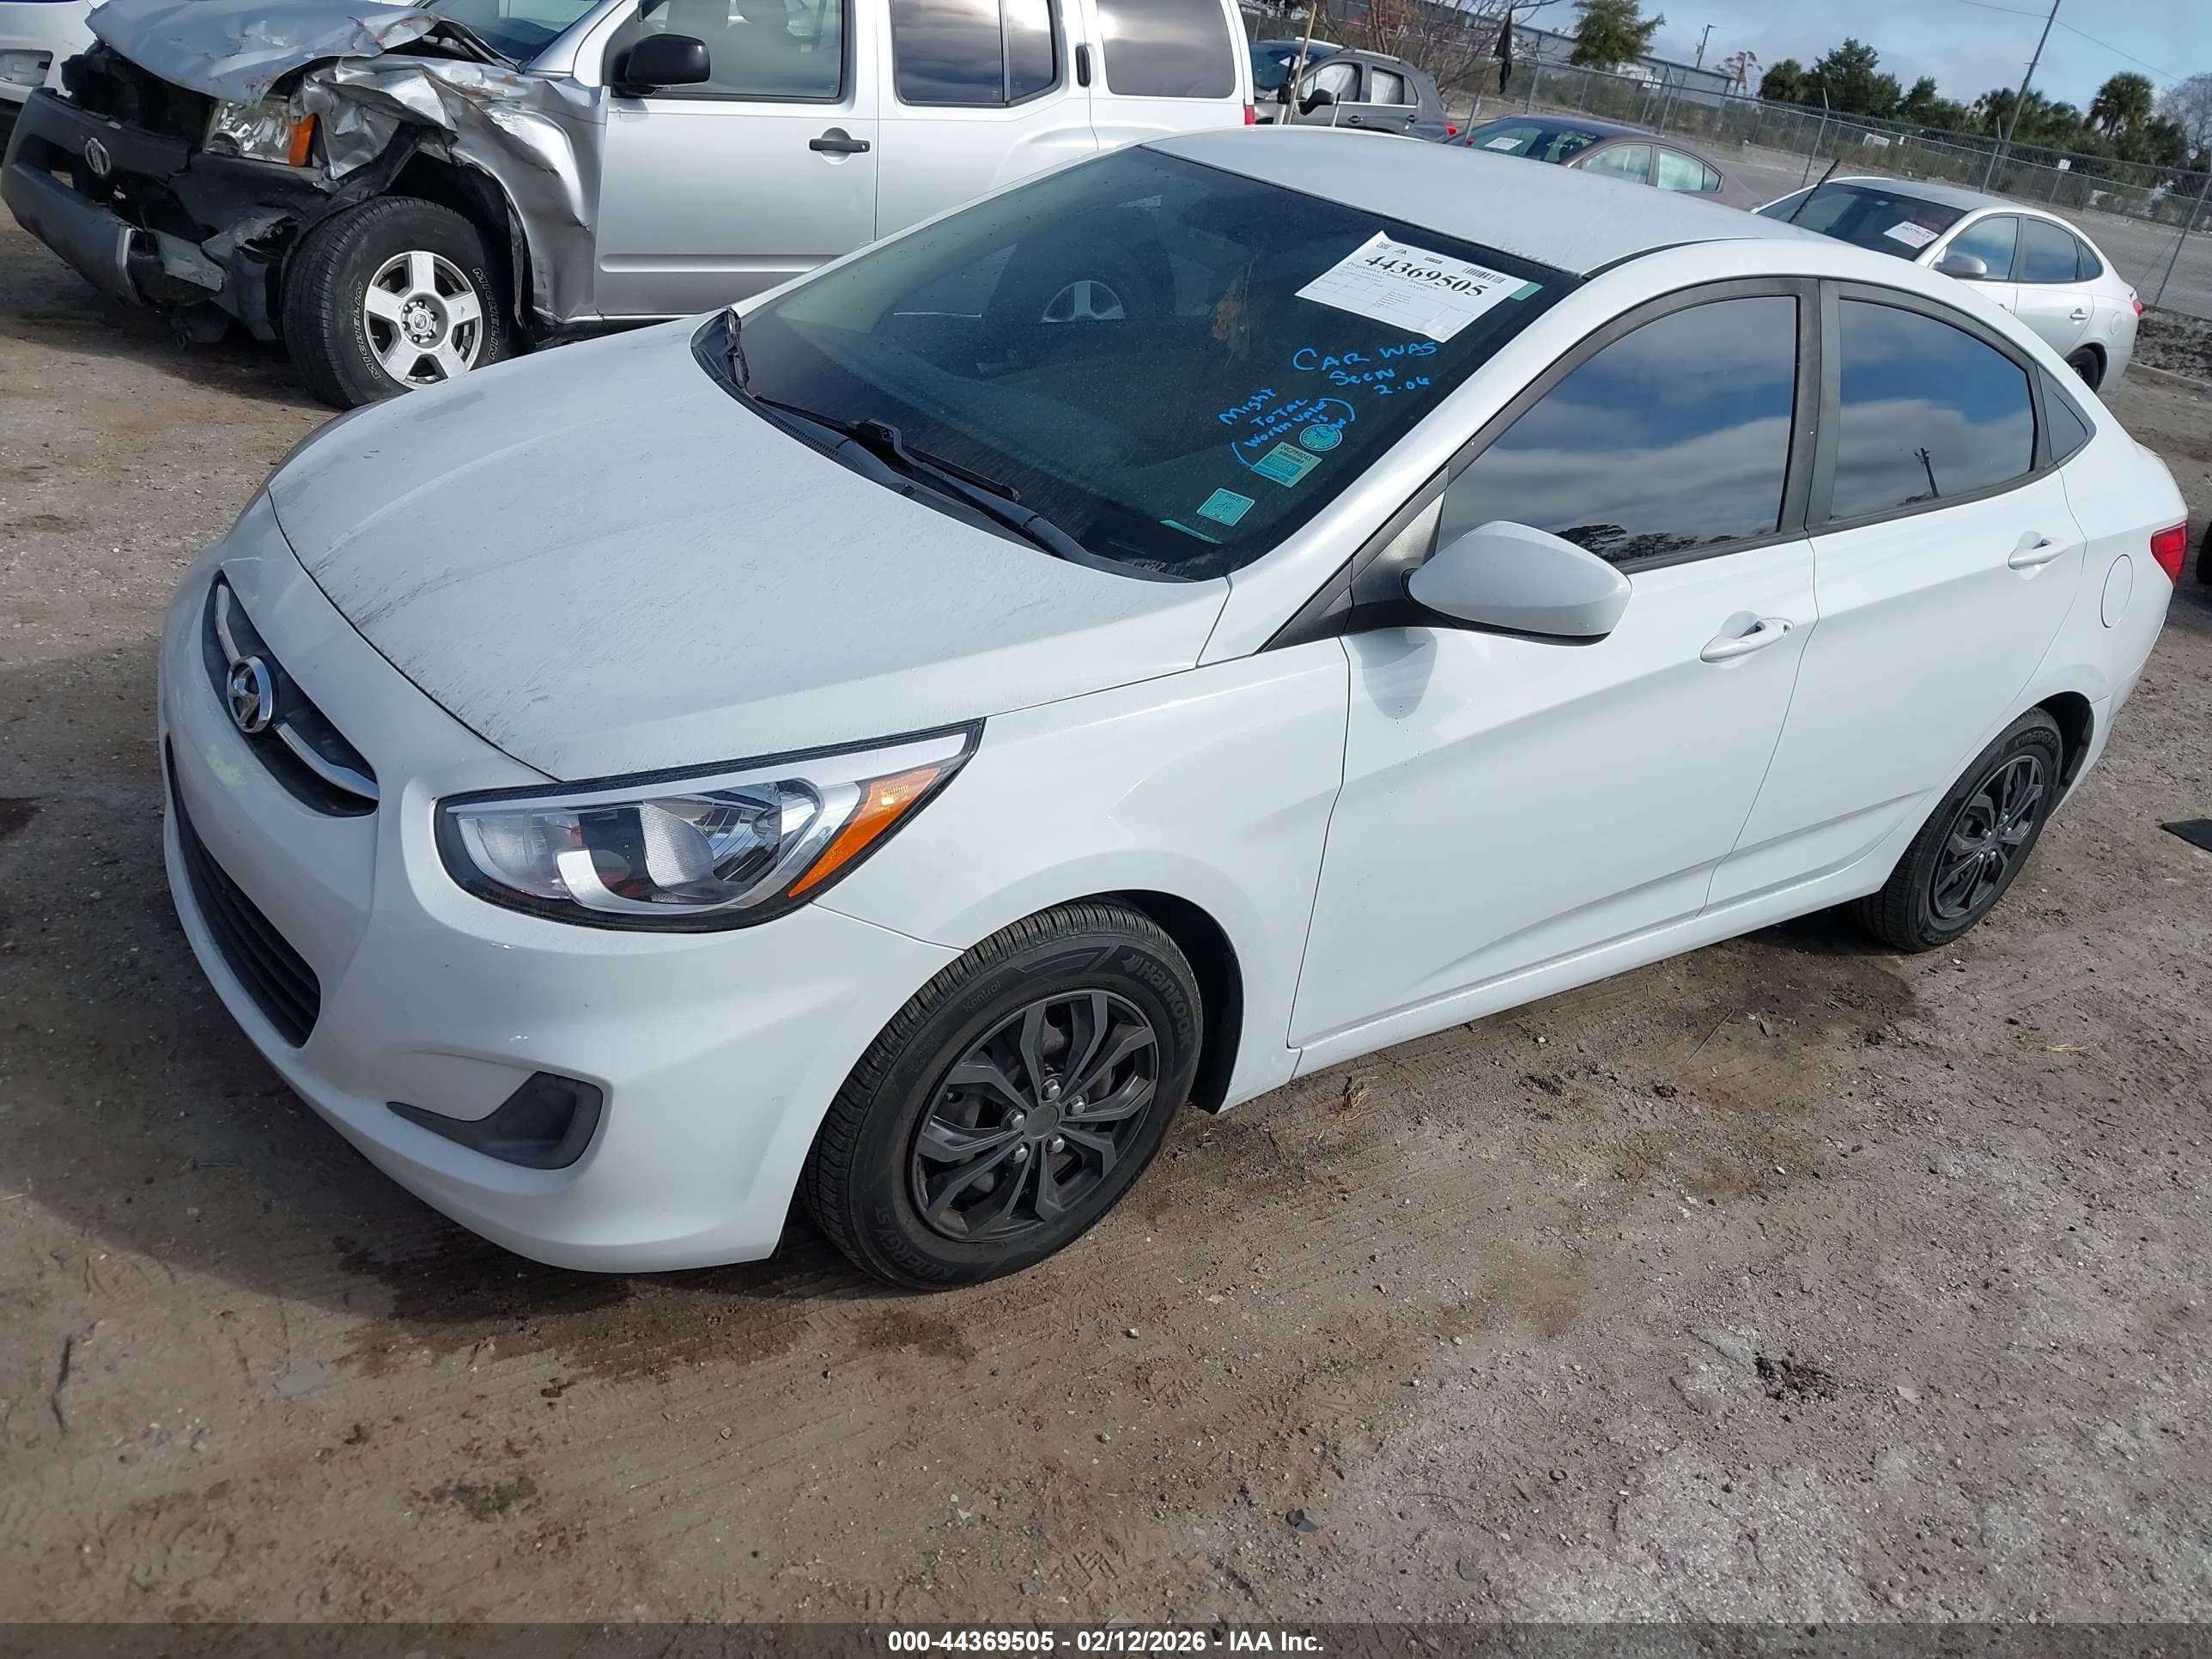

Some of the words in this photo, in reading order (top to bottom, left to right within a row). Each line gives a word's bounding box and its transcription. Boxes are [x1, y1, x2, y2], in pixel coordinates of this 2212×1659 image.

[1364, 255, 1490, 297] 44369505
[351, 281, 381, 380] MICHELIN
[471, 268, 501, 361] MICHELIN
[1378, 342, 1437, 359] WAS
